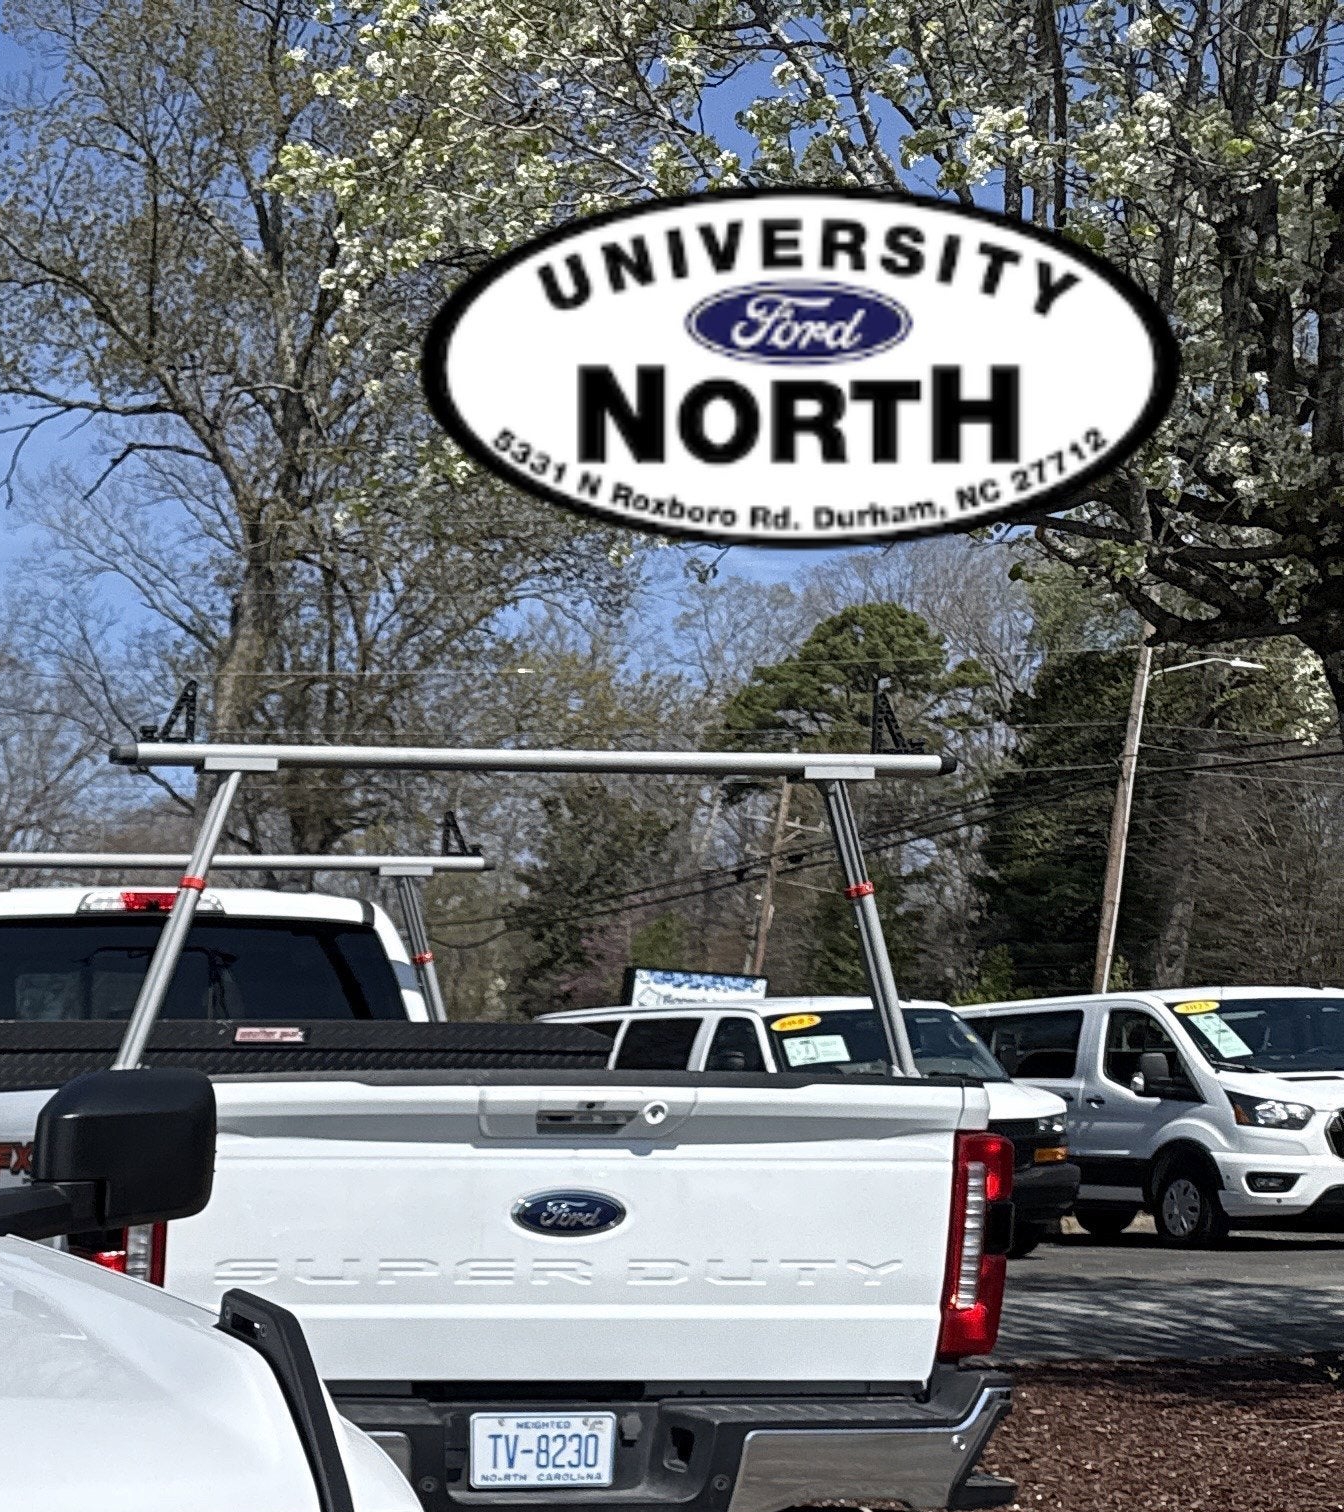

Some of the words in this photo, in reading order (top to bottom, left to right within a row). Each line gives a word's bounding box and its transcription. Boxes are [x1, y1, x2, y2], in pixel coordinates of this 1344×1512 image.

[540, 1200, 602, 1227] Ford
[214, 1257, 594, 1286] SUPER
[626, 1257, 904, 1286] DUTY
[515, 1420, 571, 1430] WEIGHTED
[487, 1433, 599, 1469] TV-8230
[480, 1473, 528, 1482] NORTH
[536, 1472, 602, 1482] CAROLINA
